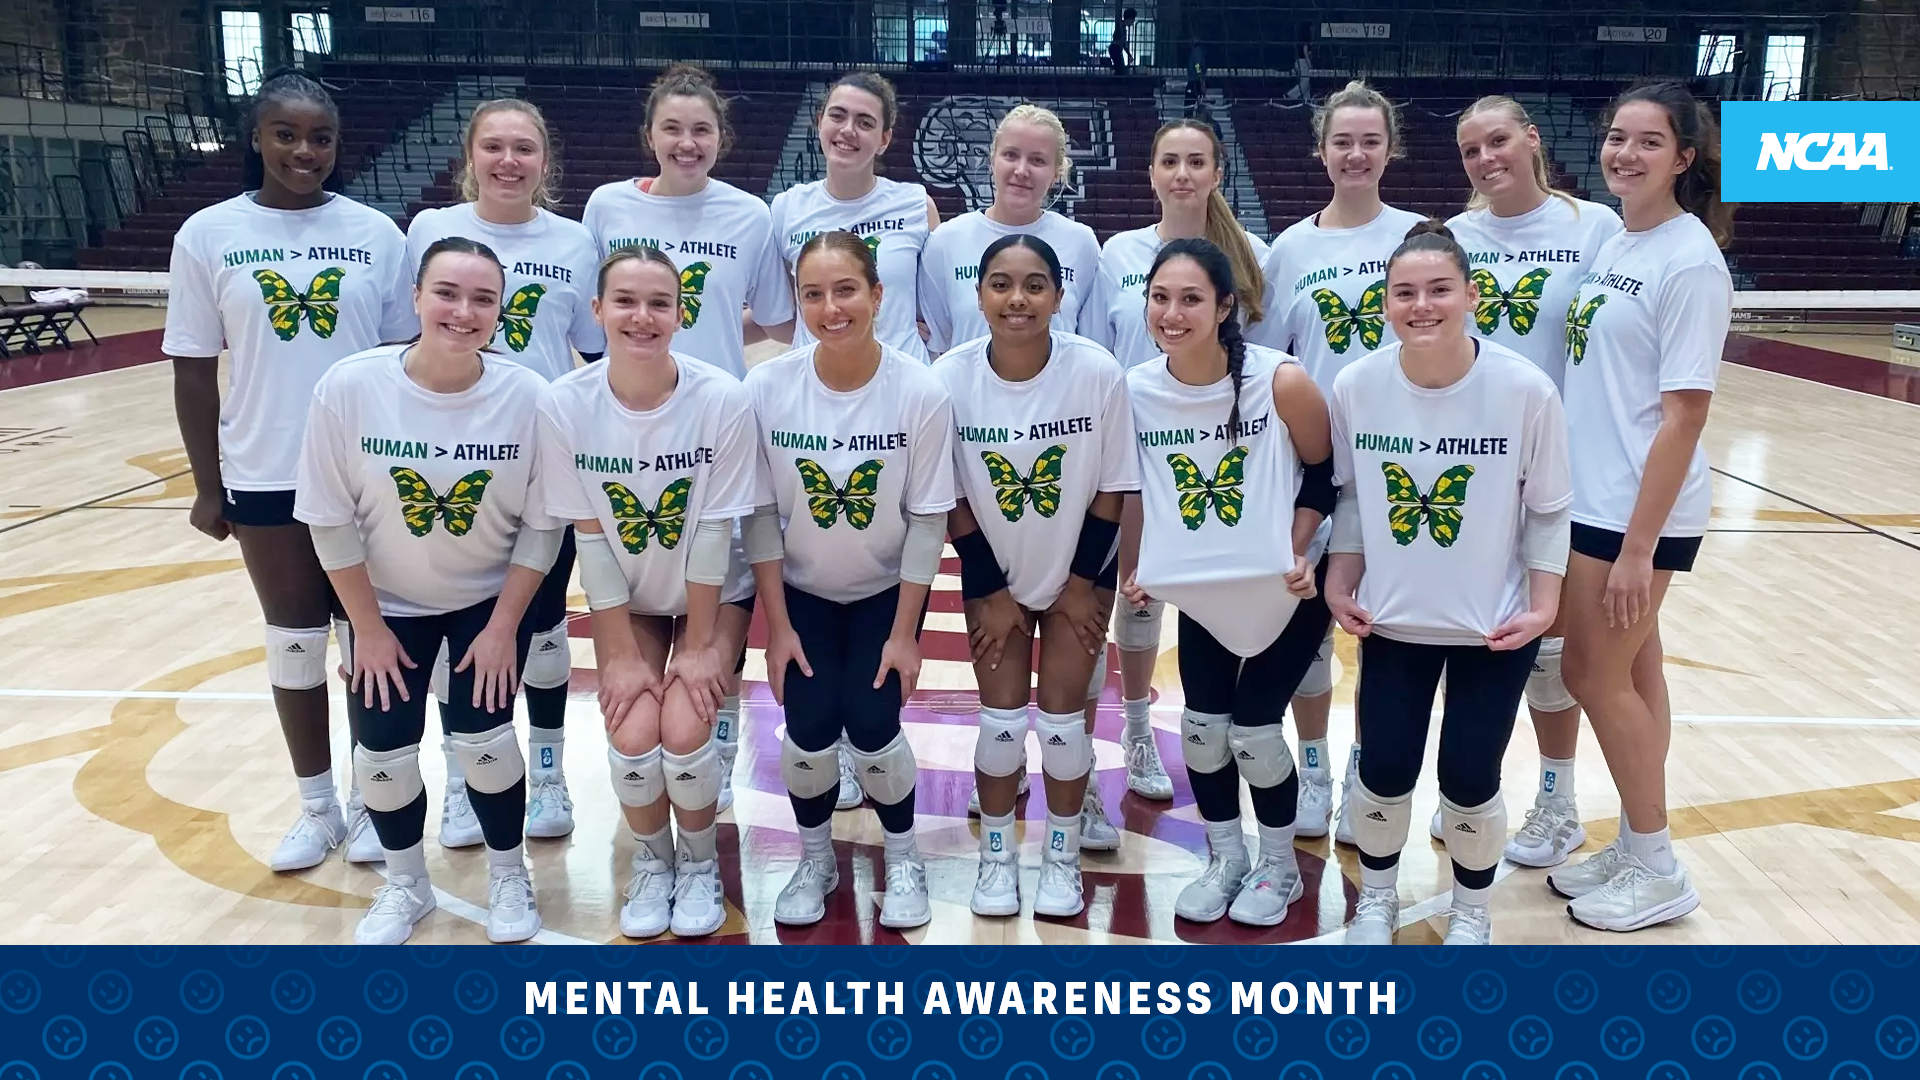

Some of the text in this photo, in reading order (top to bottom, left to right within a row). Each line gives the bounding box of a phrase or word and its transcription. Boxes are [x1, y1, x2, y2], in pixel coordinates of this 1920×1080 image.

[1025, 21, 1044, 32] 118
[790, 231, 820, 246] HUM
[224, 249, 284, 267] HUMAN
[308, 247, 371, 265] ATHLETE
[679, 241, 737, 259] ATHLETE
[1468, 251, 1500, 264] MAN
[1518, 250, 1580, 263] ATHLETE
[513, 262, 572, 283] ATHLETE
[955, 265, 980, 280] HUM
[1121, 273, 1149, 288] HUM
[1295, 266, 1337, 295] HUMAN
[1600, 273, 1643, 296] ATHLETE
[957, 426, 1008, 443] HUMAN
[1029, 416, 1093, 440] ATHLETE
[1140, 428, 1194, 447] HUMAN
[361, 436, 428, 459] HUMAN
[453, 444, 520, 460] ATHLETE
[771, 430, 827, 451] HUMAN
[848, 432, 907, 451] ATHLETE
[1355, 433, 1414, 454] HUMAN
[1436, 438, 1508, 455] ATHLETE
[575, 454, 633, 474] HUMAN
[655, 447, 713, 472] ATHLETE
